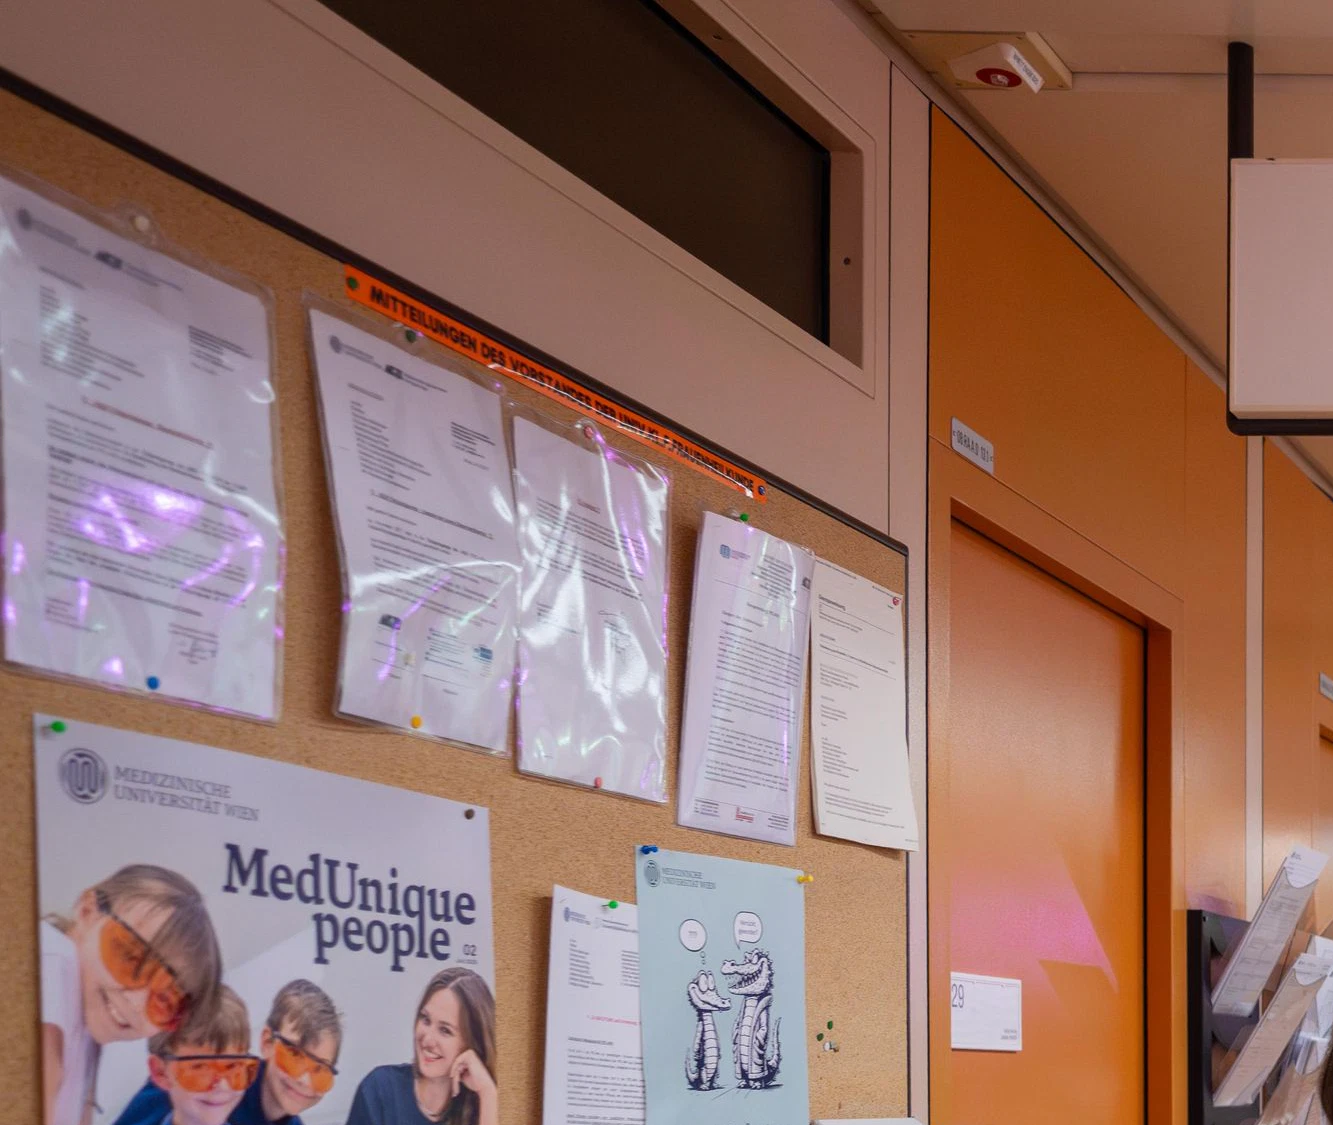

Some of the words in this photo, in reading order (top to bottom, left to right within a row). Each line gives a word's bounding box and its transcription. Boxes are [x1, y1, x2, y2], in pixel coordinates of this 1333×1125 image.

[370, 286, 477, 353] MITTEILUNGEN
[480, 342, 505, 366] DES
[114, 766, 232, 798] MEDIZINISCHE
[114, 784, 220, 815] UNIVERSITÄT
[223, 803, 260, 821] WIEN
[222, 842, 476, 930] MedUnique
[312, 911, 451, 972] people
